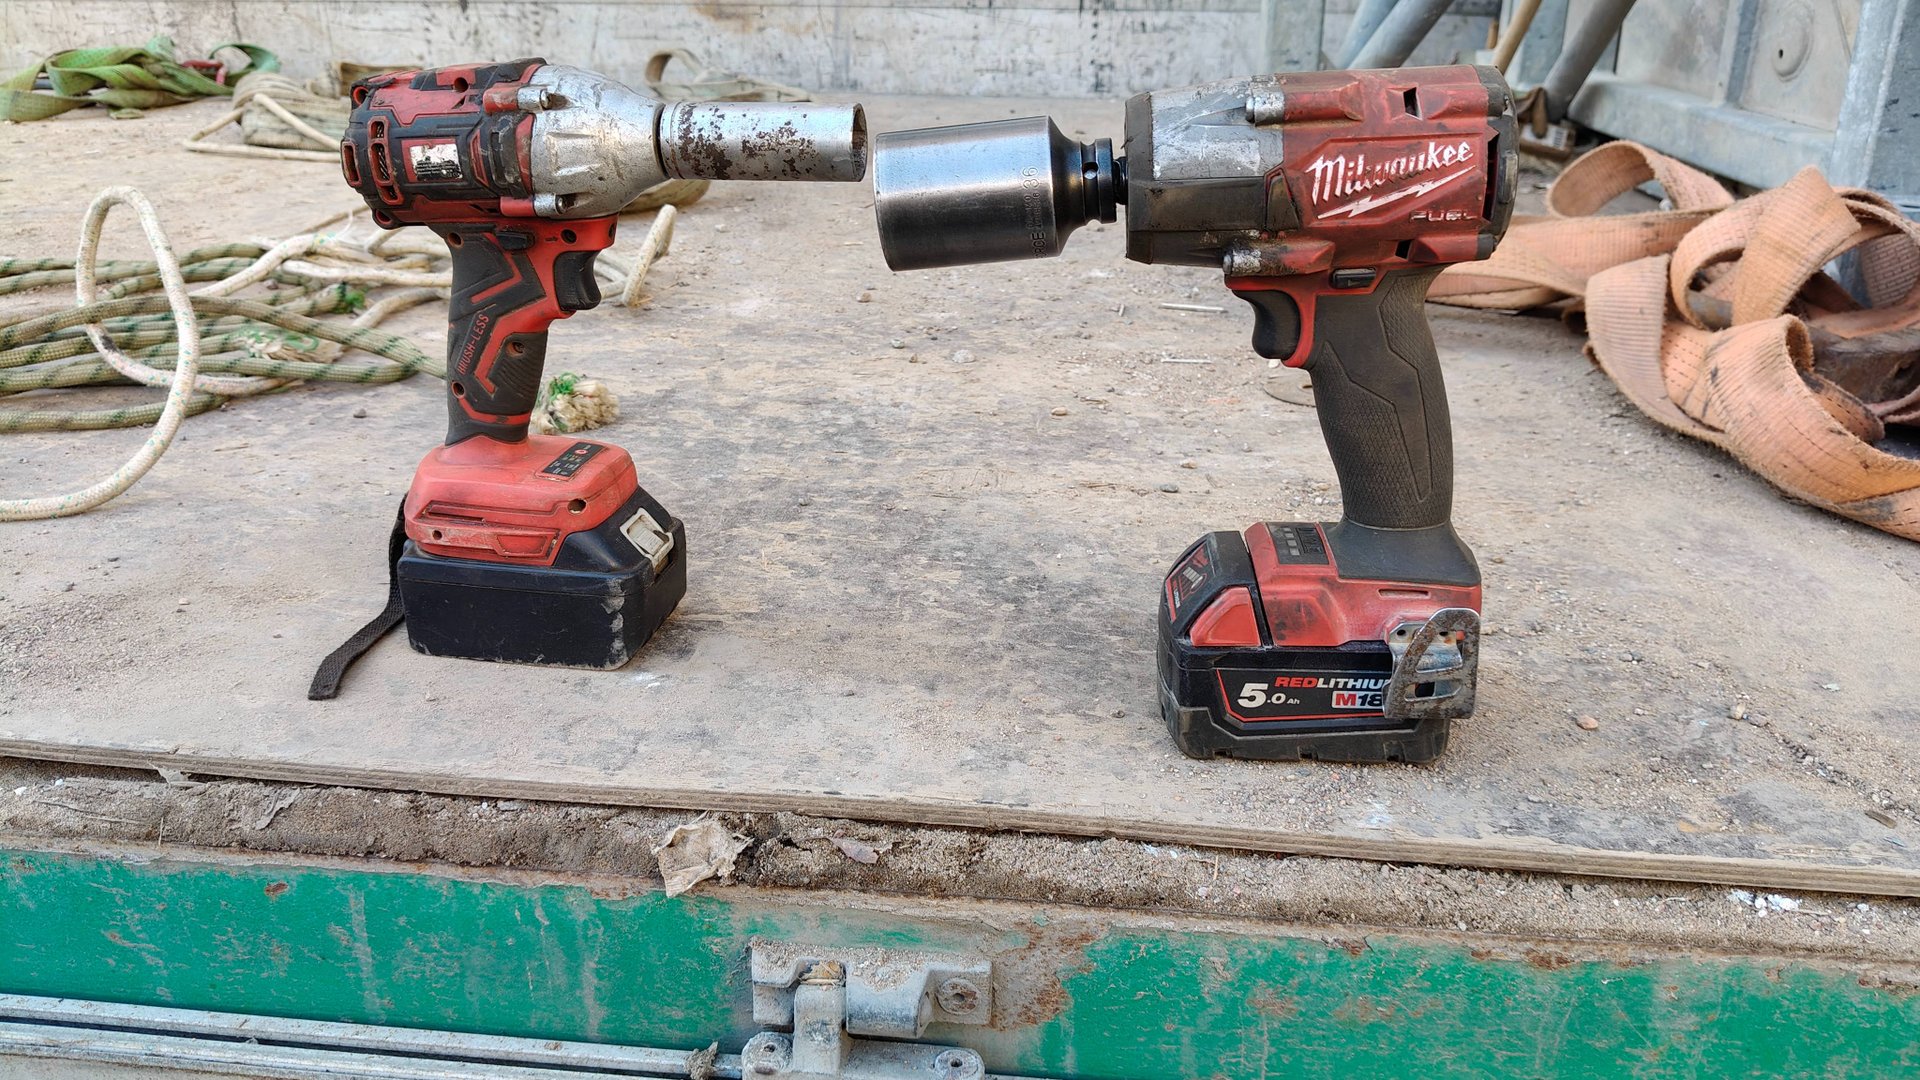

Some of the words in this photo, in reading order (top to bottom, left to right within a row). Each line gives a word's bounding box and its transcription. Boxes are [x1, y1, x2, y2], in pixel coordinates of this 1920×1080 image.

[1021, 167, 1040, 190] 36
[1304, 141, 1474, 206] Milwaukee
[1409, 209, 1478, 223] FUEL
[456, 313, 490, 376] BRUSH-LESS
[1237, 682, 1287, 708] 5.0
[1287, 697, 1300, 705] Ah
[1334, 693, 1383, 707] M18
